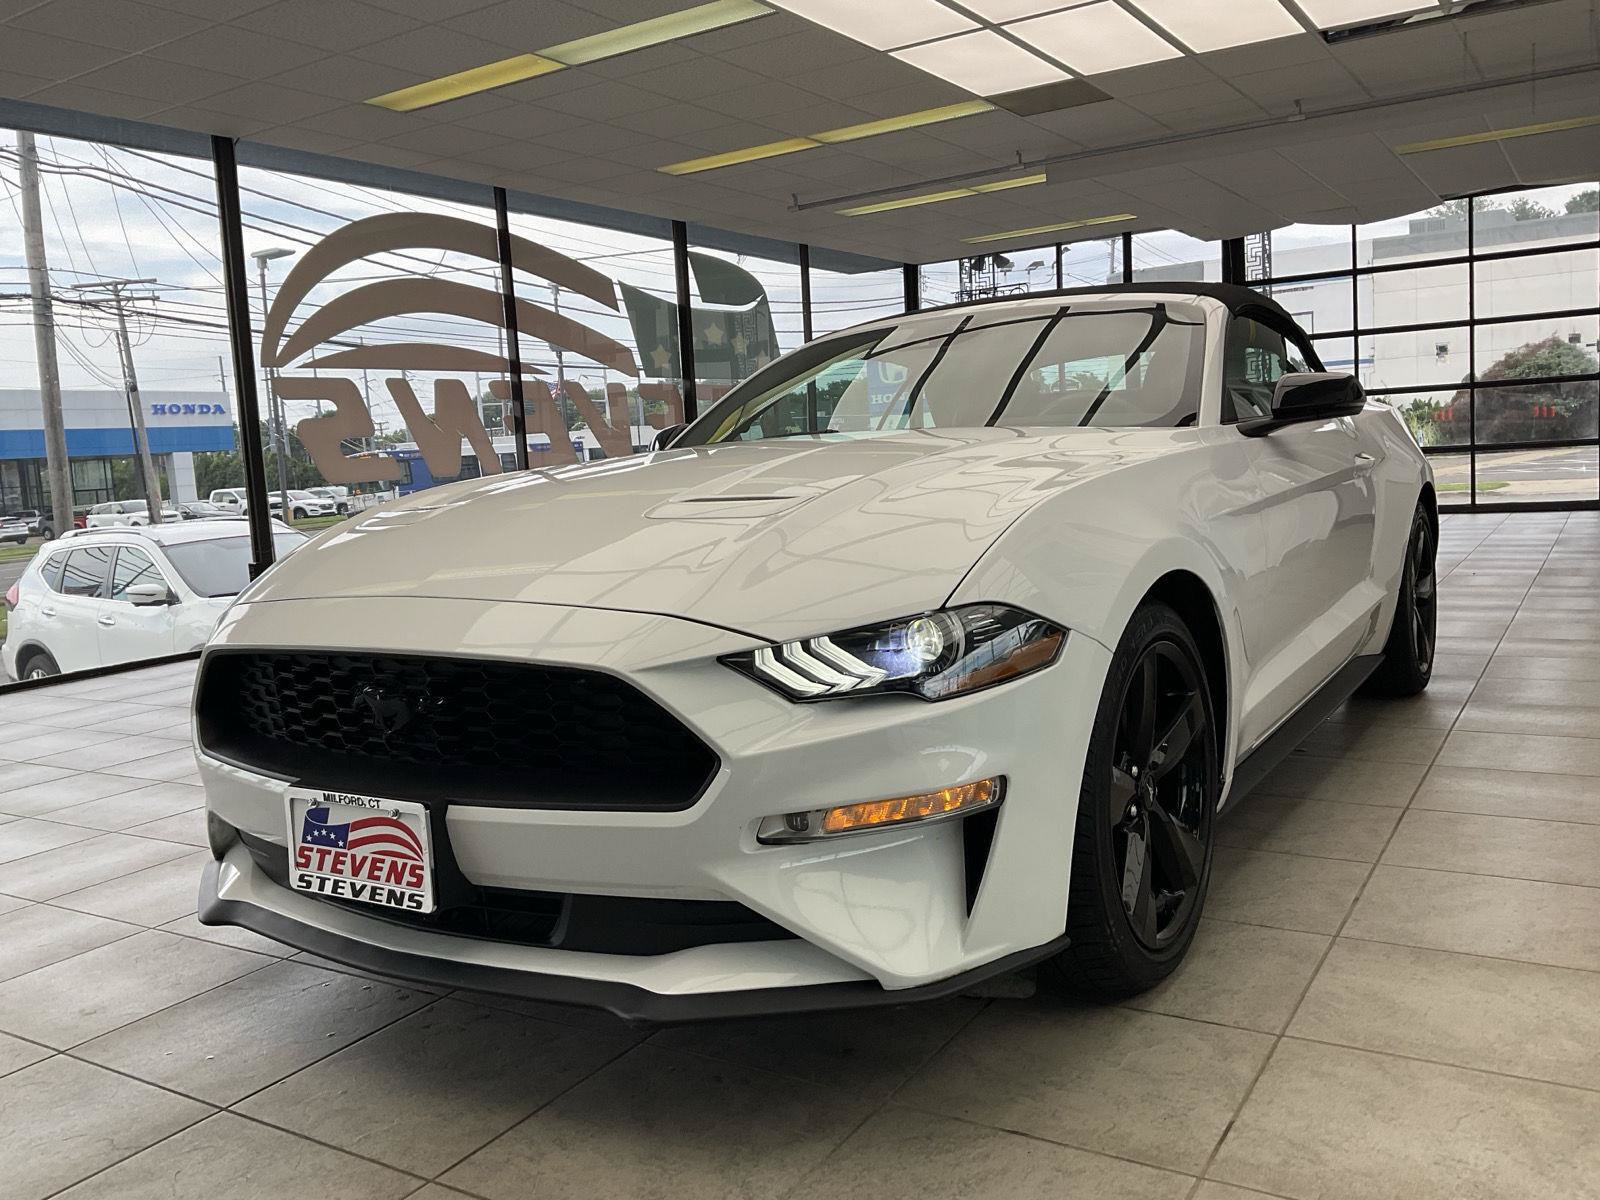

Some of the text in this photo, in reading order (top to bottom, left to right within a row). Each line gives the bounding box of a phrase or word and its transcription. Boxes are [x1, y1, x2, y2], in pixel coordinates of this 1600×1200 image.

[151, 403, 226, 415] HONDA
[368, 799, 381, 809] CT
[296, 846, 425, 889] STEVENS
[296, 873, 425, 910] STEVENS
